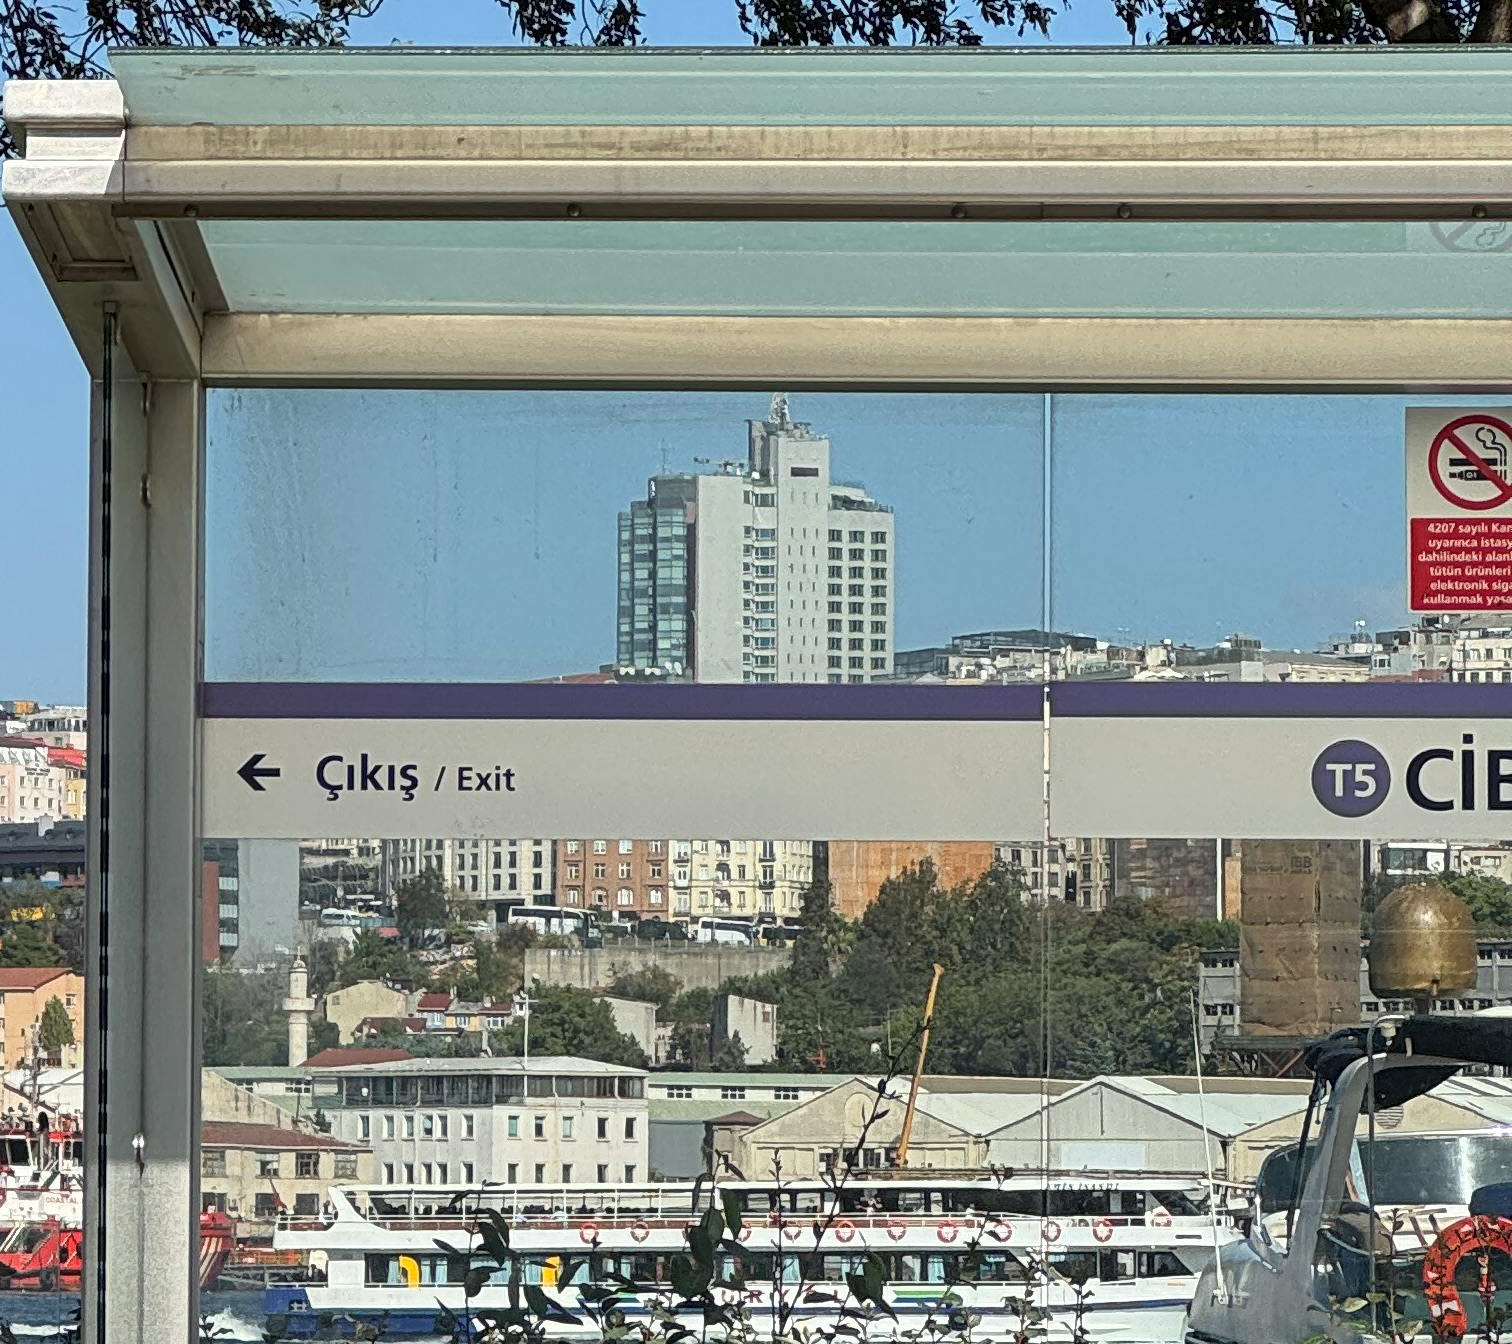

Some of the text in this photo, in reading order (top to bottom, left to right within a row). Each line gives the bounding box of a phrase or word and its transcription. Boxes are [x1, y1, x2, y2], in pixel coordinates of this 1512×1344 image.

[1427, 522, 1456, 533] 4207
[1417, 551, 1483, 561] dahilindeki
[1429, 565, 1511, 575] tütün ürünleri
[1429, 579, 1489, 589] elektronik
[1422, 593, 1484, 603] kullanmak
[315, 752, 516, 802] Çıkış / Exit
[1325, 762, 1378, 799] T5
